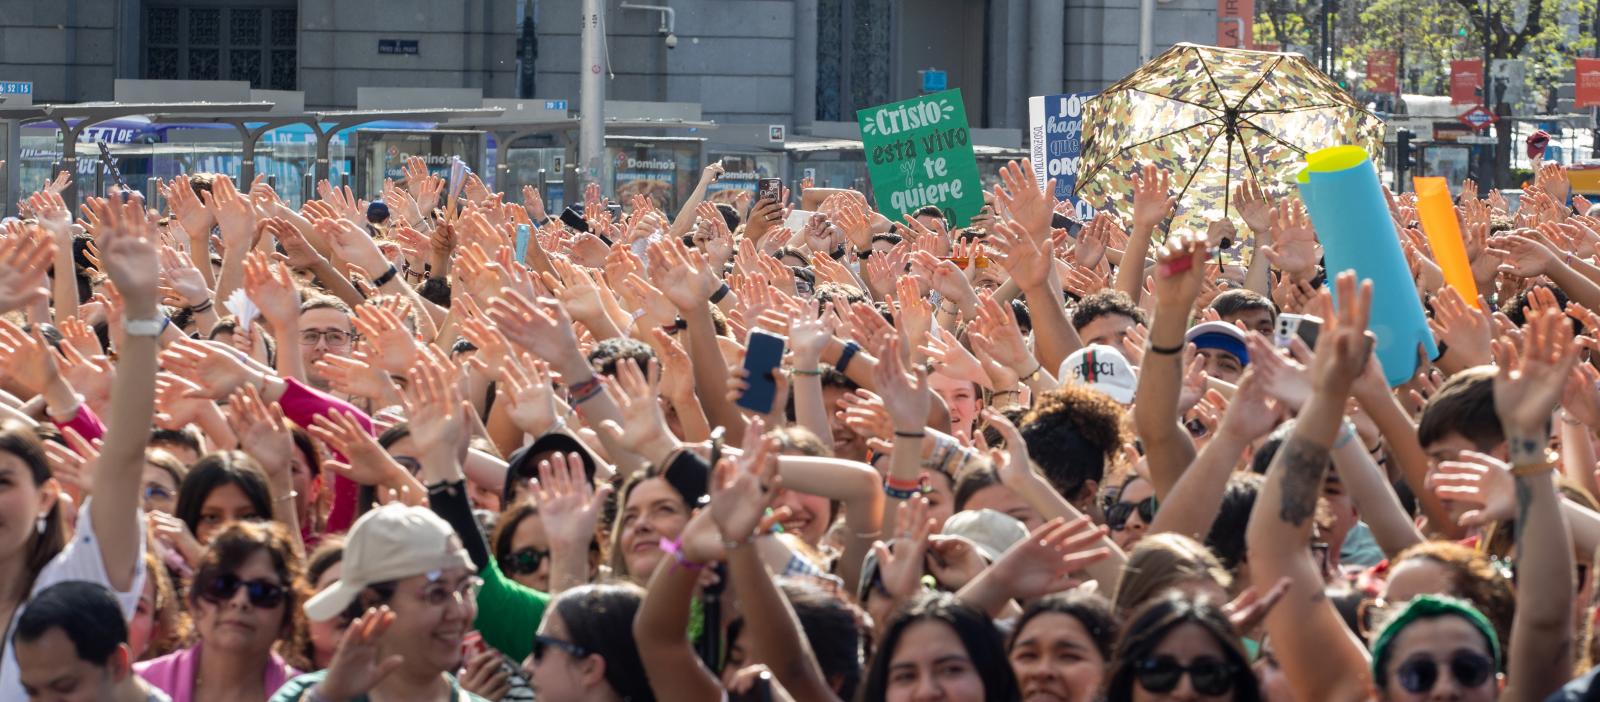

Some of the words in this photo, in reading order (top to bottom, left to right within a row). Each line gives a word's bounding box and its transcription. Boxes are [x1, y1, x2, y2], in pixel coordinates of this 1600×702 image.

[8, 83, 16, 93] 52
[20, 83, 29, 93] 15
[1059, 94, 1097, 118] JÓ
[876, 101, 942, 136] Cristo
[873, 135, 917, 165] está
[922, 127, 968, 155] vivo
[400, 152, 453, 164] Dino's
[627, 157, 675, 170] Domino's
[923, 157, 948, 179] te
[891, 179, 963, 215] quiere
[1073, 362, 1115, 379] GUCCI
